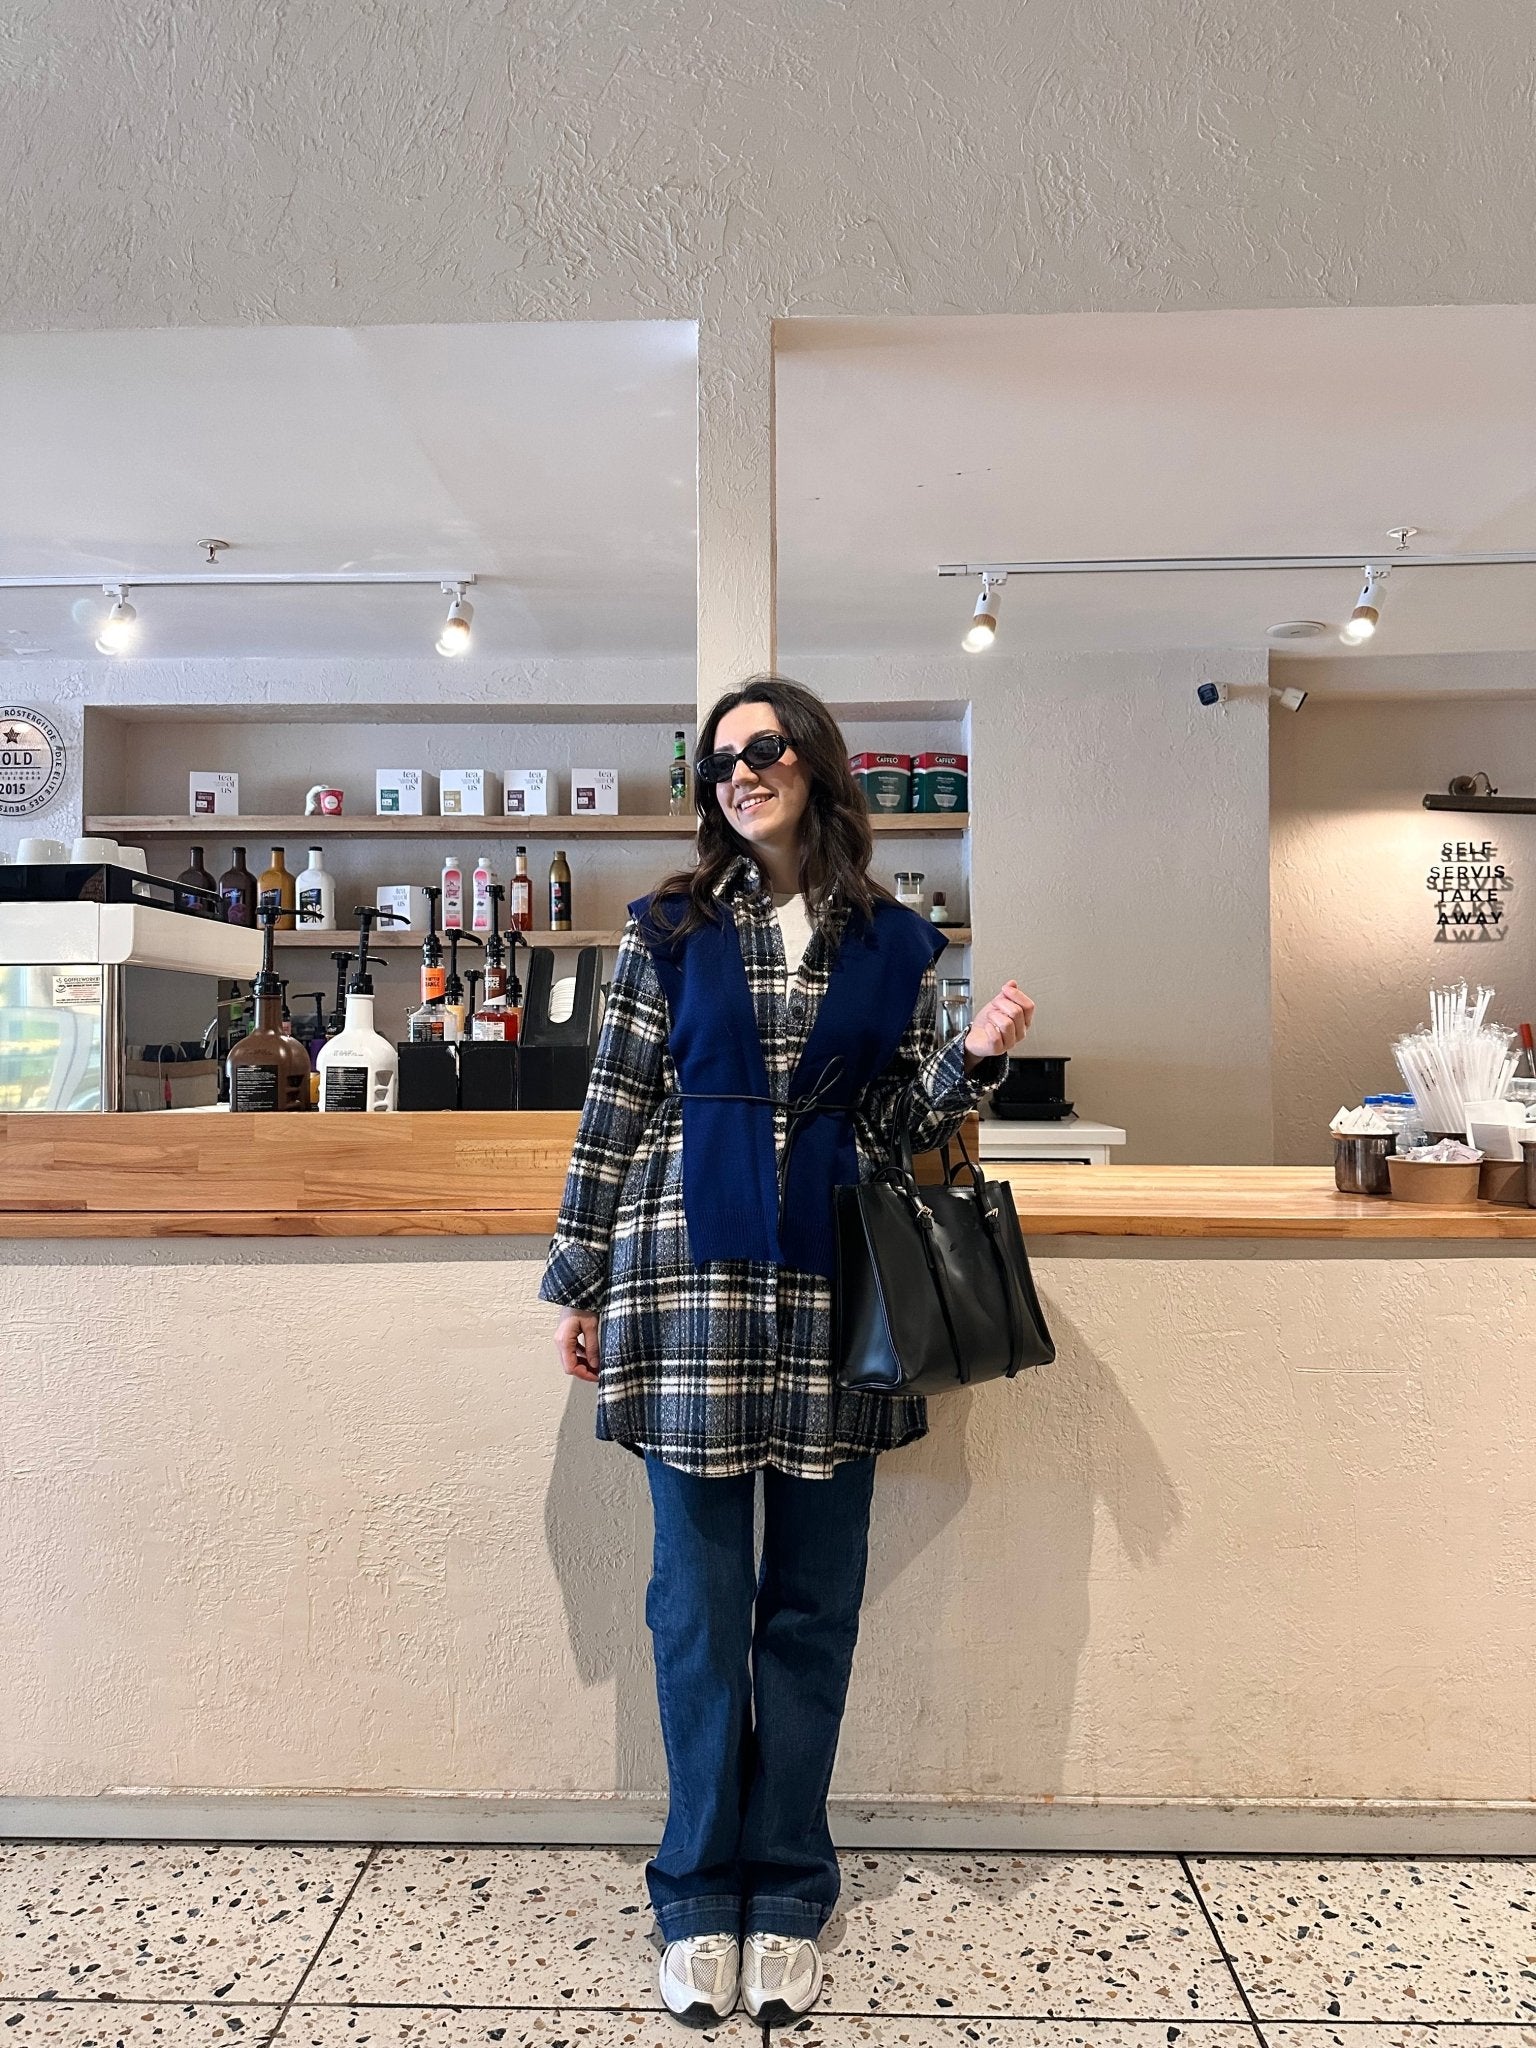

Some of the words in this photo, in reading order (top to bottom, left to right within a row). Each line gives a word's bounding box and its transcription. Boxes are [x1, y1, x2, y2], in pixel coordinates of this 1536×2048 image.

[4, 708, 56, 741] RÖSTERGILDE
[2, 752, 33, 766] OLD
[598, 770, 612, 778] tea
[0, 783, 26, 795] 2015
[44, 771, 61, 795] ELITE
[30, 795, 45, 808] DES
[0, 804, 26, 813] DEUTS
[1442, 842, 1492, 855] SELF
[1430, 865, 1505, 878] SERVIS
[1437, 888, 1498, 903] TAKE
[1436, 911, 1503, 925] AWAY
